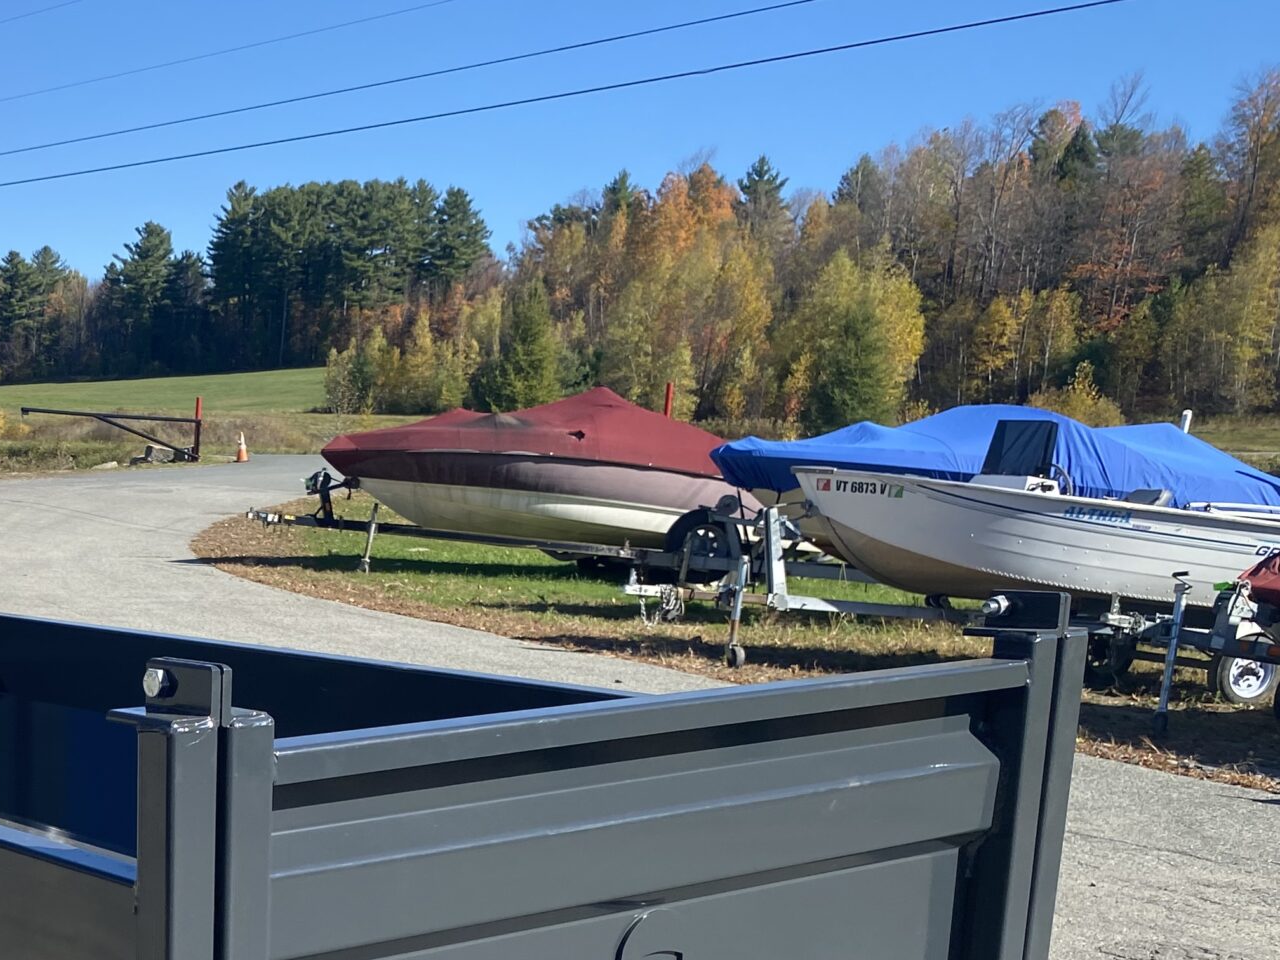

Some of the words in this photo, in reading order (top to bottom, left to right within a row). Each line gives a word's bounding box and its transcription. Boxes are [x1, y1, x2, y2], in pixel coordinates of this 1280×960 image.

[836, 480, 848, 492] VT
[851, 481, 877, 494] 6873
[880, 483, 888, 495] V
